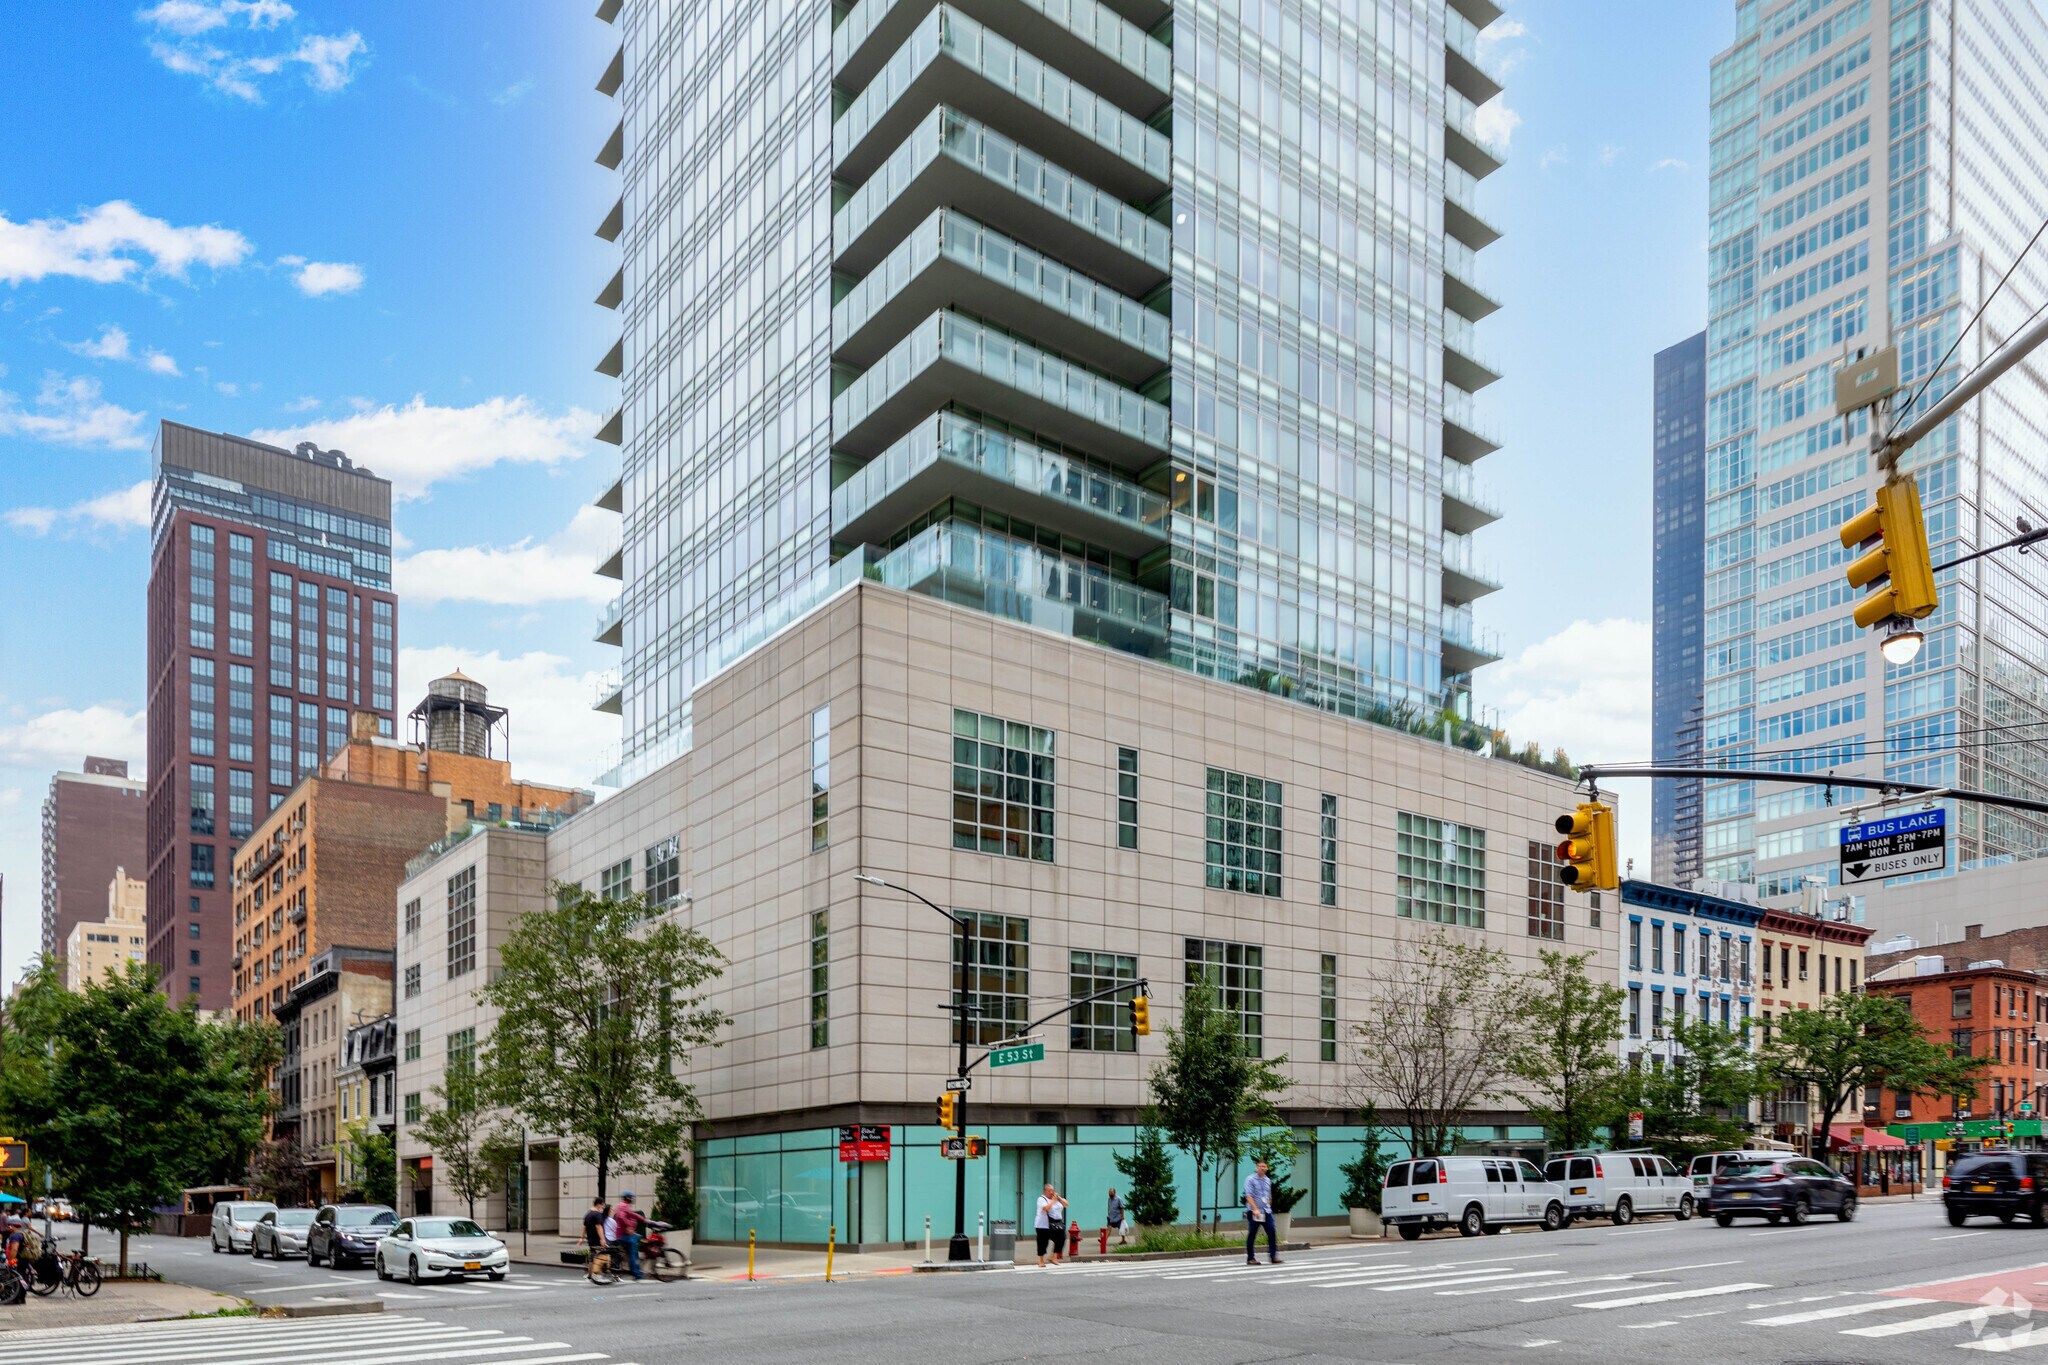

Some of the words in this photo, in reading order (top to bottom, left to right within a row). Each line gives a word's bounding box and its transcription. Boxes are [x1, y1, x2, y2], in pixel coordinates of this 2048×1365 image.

[1868, 822, 1895, 836] BUS
[1900, 814, 1937, 830] LANE
[1845, 837, 1891, 853] 7AM-10AM
[1896, 828, 1941, 844] 2PM-7PM
[1869, 846, 1890, 858] MON
[1898, 842, 1915, 853] FRI
[1875, 858, 1908, 873] BUSES
[1913, 853, 1940, 866] ONLY
[998, 1052, 1005, 1064] E
[1007, 1050, 1020, 1062] 53
[1022, 1048, 1034, 1060] St
